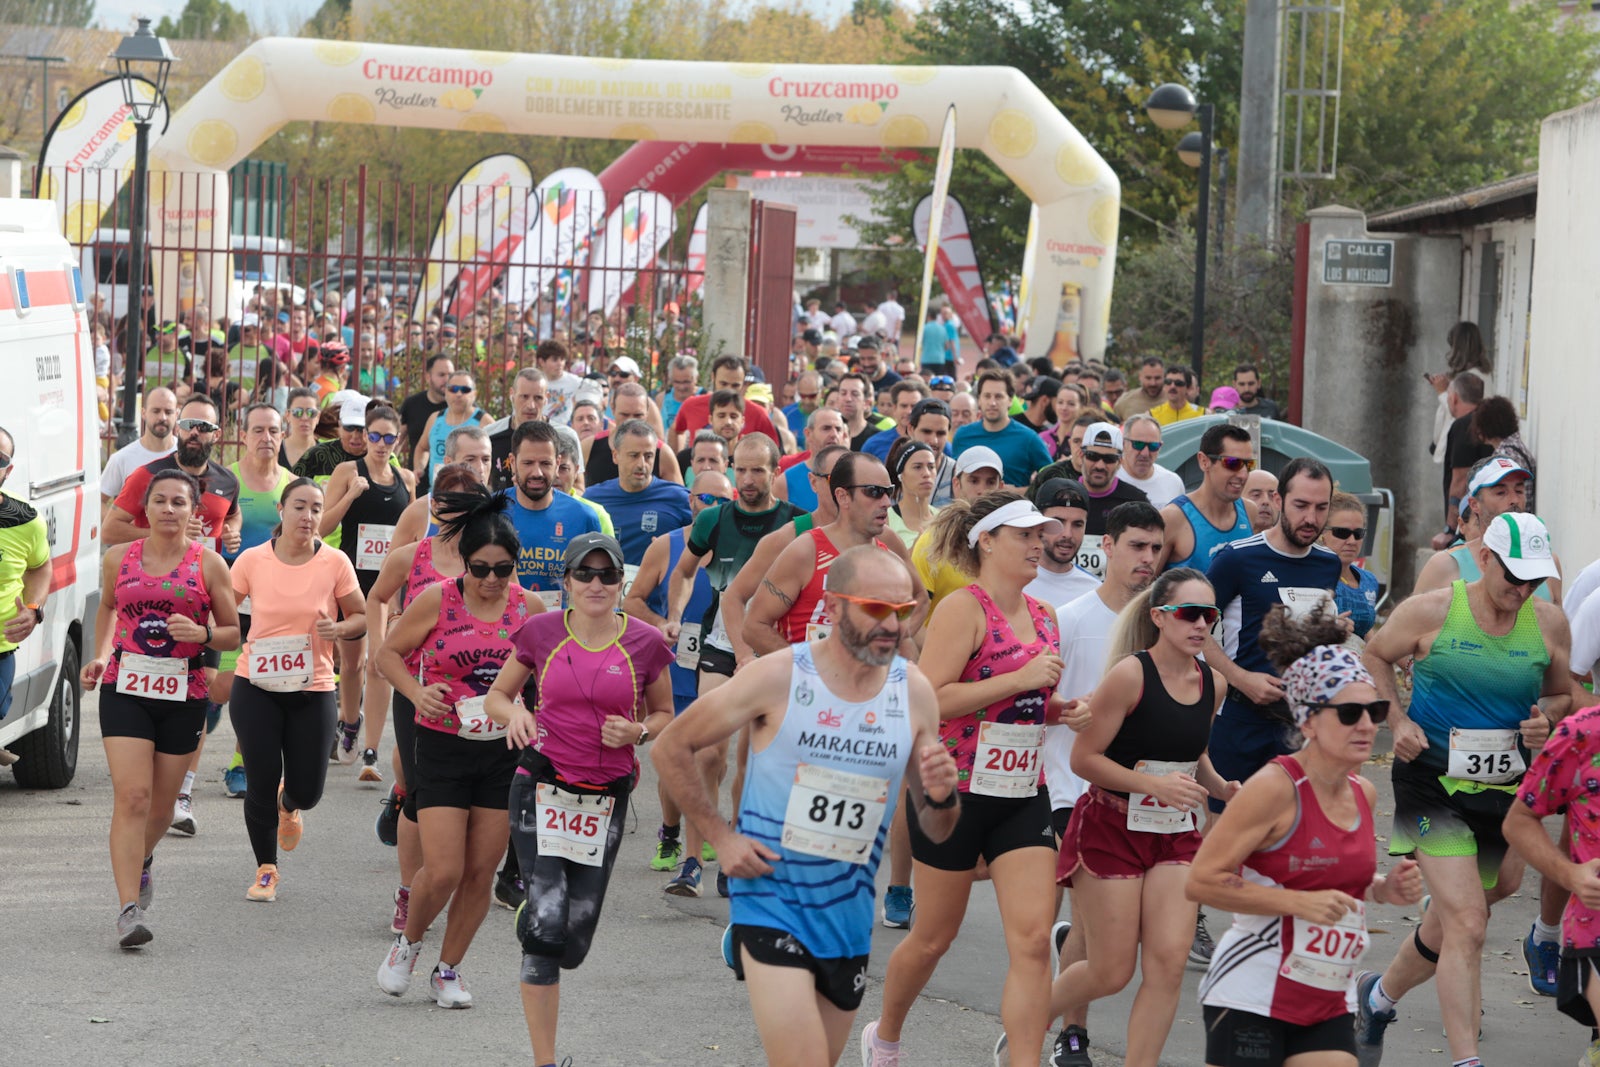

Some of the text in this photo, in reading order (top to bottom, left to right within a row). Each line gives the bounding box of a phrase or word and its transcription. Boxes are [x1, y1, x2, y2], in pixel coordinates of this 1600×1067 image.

[363, 58, 493, 88] Cruzcampo
[375, 87, 437, 109] Radler
[526, 76, 553, 92] CON
[557, 78, 596, 95] ZUMO
[600, 80, 661, 97] NATURAL
[666, 82, 683, 98] DE
[768, 77, 899, 101] Cruzcampo
[525, 95, 731, 120] DOBLEMENTE REFRESCANTE
[780, 104, 843, 126] Radler
[65, 104, 132, 173] Cruzcampo
[1347, 244, 1385, 256] CALLE
[1076, 553, 1100, 569] 30
[256, 652, 306, 674] 2164
[125, 672, 179, 695] 2149
[798, 731, 898, 759] MARACENA
[810, 751, 832, 759] CLUB
[844, 757, 887, 767] ATLETISMO
[985, 747, 1038, 772] 2041
[1466, 754, 1511, 775] 315
[545, 807, 599, 837] 2145
[808, 795, 866, 830] 813
